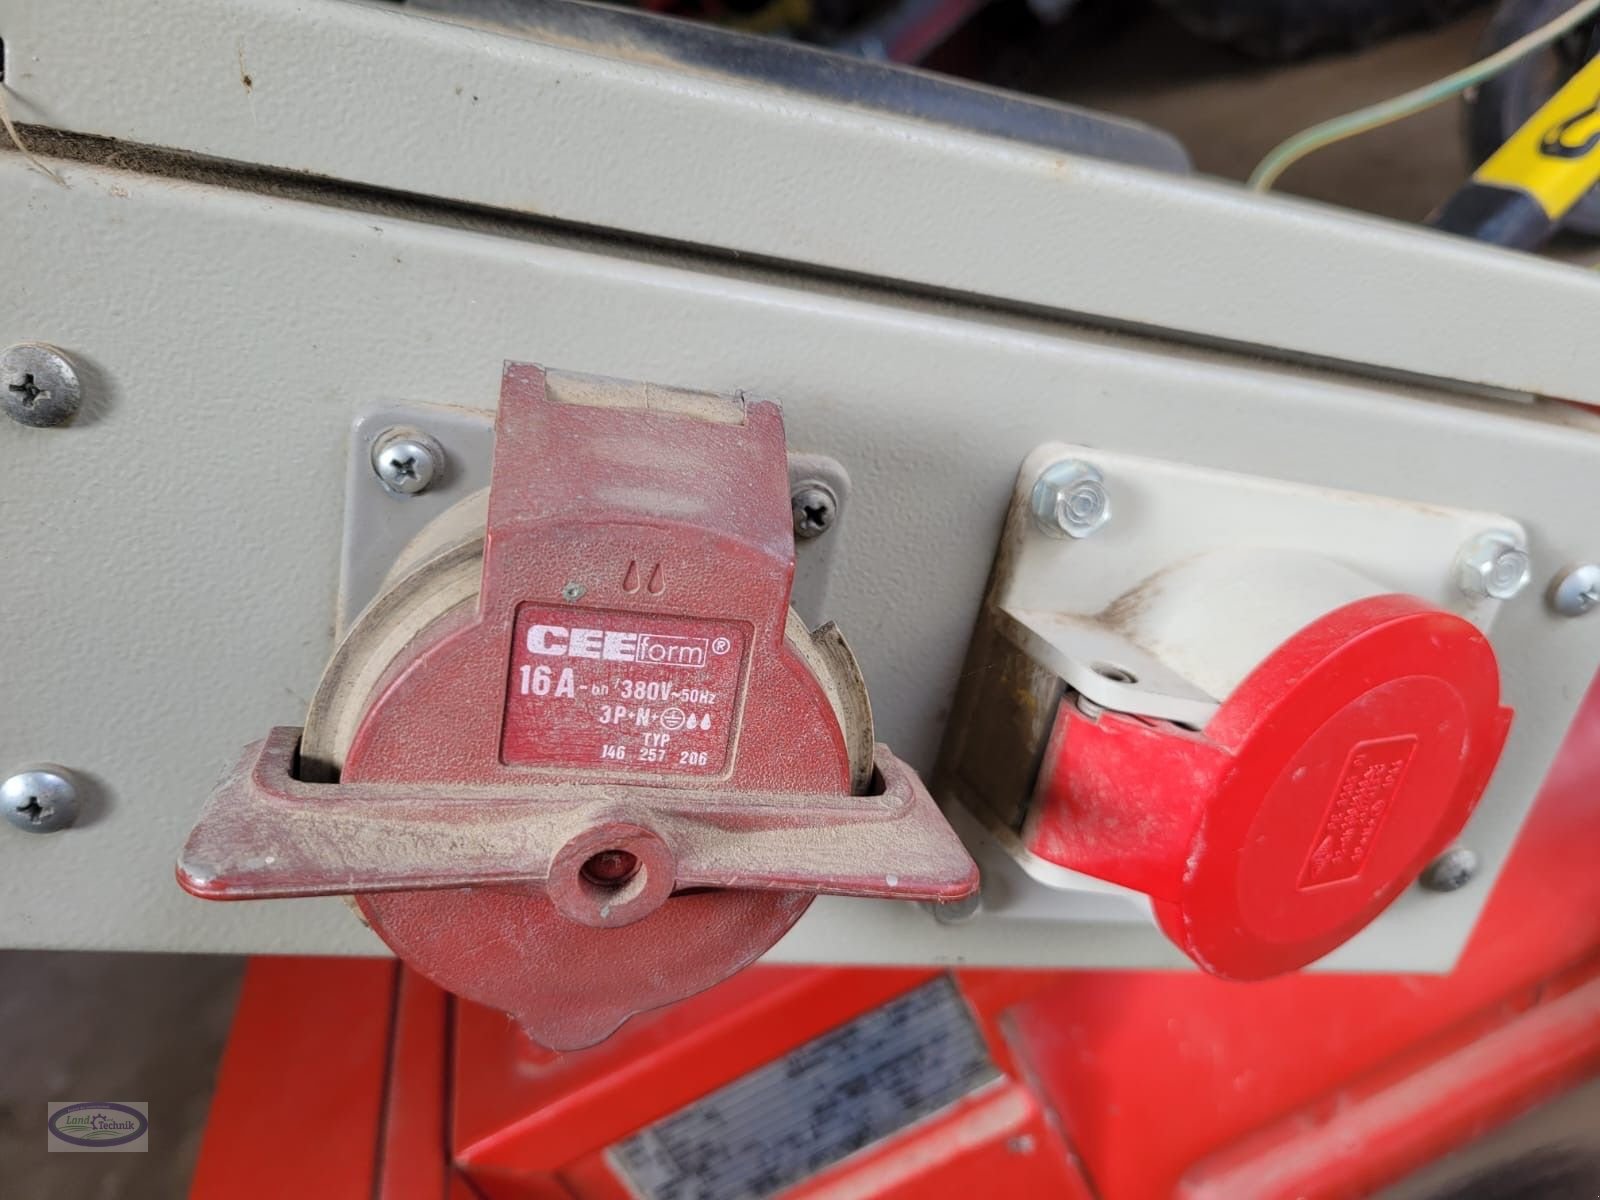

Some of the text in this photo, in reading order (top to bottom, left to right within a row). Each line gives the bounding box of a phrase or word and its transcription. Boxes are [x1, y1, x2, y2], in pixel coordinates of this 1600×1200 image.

[643, 732, 671, 747] TYP
[601, 745, 626, 760] 146
[639, 748, 666, 762] 257
